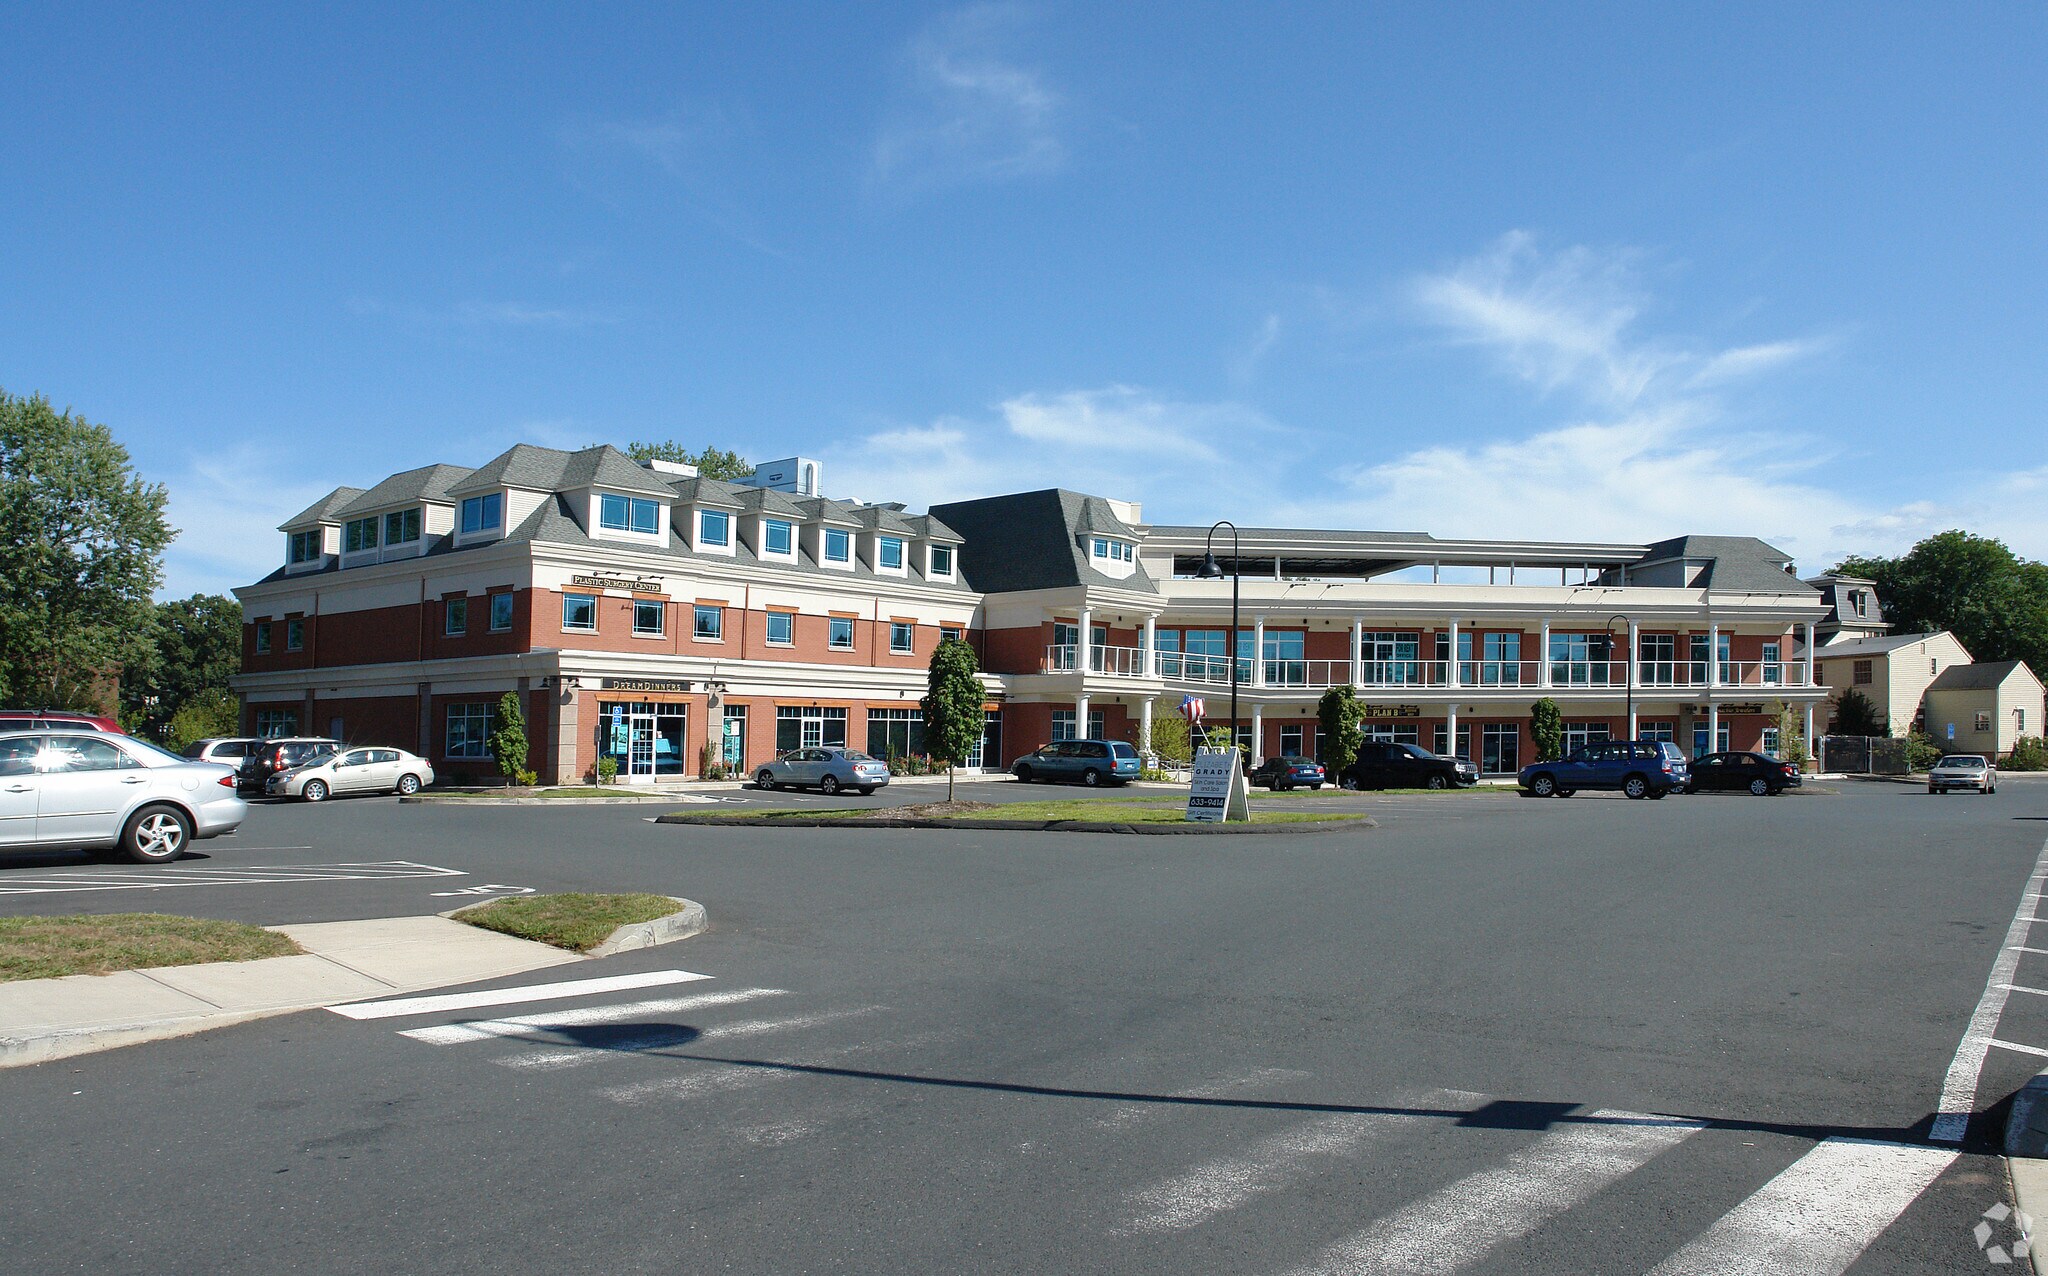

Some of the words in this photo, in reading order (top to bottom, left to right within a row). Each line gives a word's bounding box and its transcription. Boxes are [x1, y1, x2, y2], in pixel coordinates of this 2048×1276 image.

[574, 576, 603, 586] PLASTIC
[604, 579, 634, 589] SURGERY
[634, 581, 660, 591] CENTER
[1191, 798, 1224, 806] 633-9414
